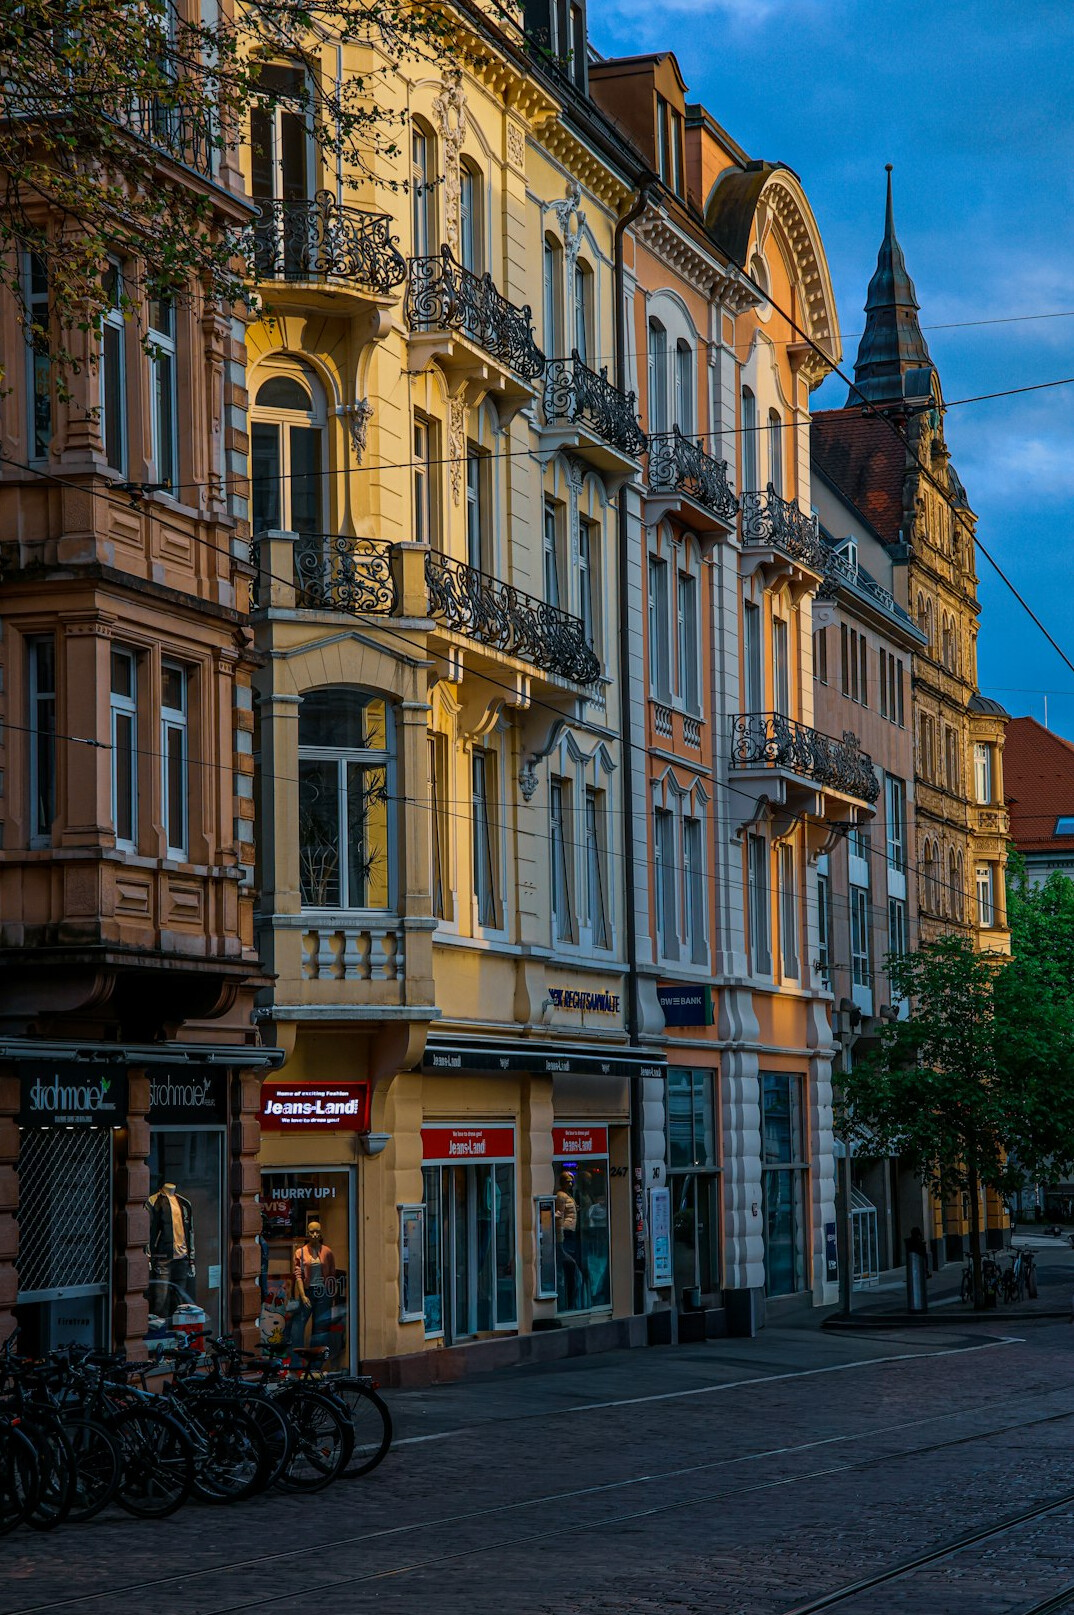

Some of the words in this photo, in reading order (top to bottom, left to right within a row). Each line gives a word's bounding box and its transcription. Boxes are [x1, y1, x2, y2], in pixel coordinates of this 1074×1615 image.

[564, 990, 620, 1013] RECHTSANWÄLTE
[272, 1188, 313, 1200] HURRY
[313, 1275, 346, 1298] 501
